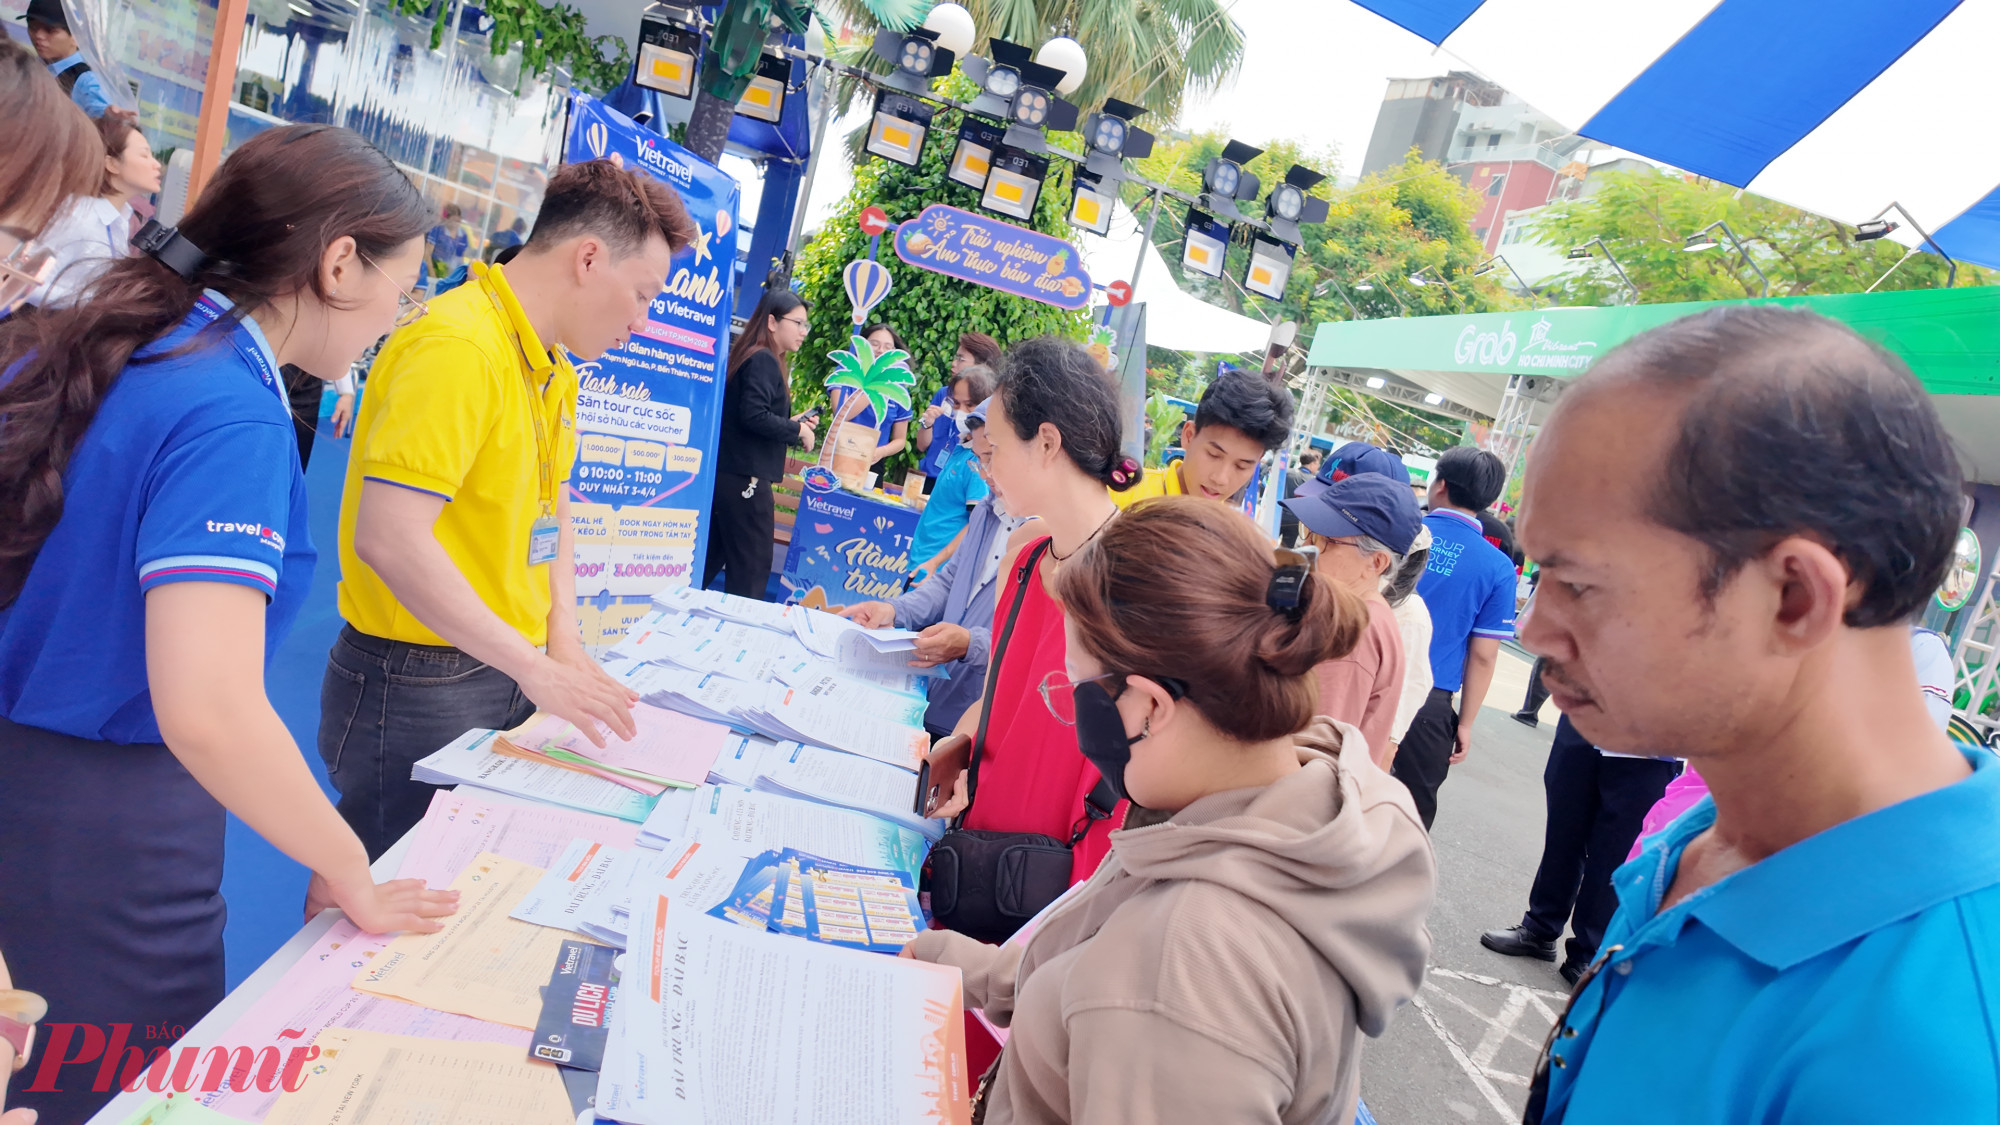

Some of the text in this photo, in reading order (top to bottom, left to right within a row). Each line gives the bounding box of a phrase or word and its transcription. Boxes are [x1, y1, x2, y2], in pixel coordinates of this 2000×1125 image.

[661, 32, 680, 43] LED
[895, 102, 913, 114] LED
[980, 131, 997, 142] LED
[635, 134, 693, 183] Vietravel
[1012, 156, 1029, 168] LED
[961, 224, 992, 248] Trải
[662, 265, 725, 308] anh
[649, 298, 716, 327] ng Vietravel
[1454, 320, 1517, 366] Grab
[246, 345, 273, 386] Vietravel
[628, 341, 651, 357] Gian
[651, 347, 676, 365] hàng
[676, 353, 715, 372] Vietravel
[1568, 355, 1593, 369] CITY
[619, 379, 652, 402] sale
[577, 394, 601, 409] Săn
[603, 399, 632, 414] tour
[655, 407, 676, 422] sốc
[647, 423, 684, 436] voucher
[591, 467, 624, 480] 10:00
[634, 471, 663, 484] 11:00
[579, 482, 657, 498] DUY NHẤT 3-4/4
[806, 496, 857, 518] Vietravel
[618, 529, 638, 537] TOUR
[639, 530, 664, 538] TRONG
[619, 519, 641, 527] BOOK
[642, 520, 661, 528] NGAY
[894, 533, 901, 547] 1
[1431, 536, 1465, 554] OUR
[835, 537, 909, 575] Hành
[1429, 554, 1457, 569] OUR
[1430, 546, 1460, 559] URNEY
[1427, 564, 1453, 577] LUE
[843, 568, 904, 599] trình
[365, 951, 405, 983] Vietravel
[560, 945, 578, 976] Vietravel
[573, 982, 607, 1027] DU LỊCH
[200, 1066, 244, 1107] ietravel
[349, 1071, 365, 1090] YORK
